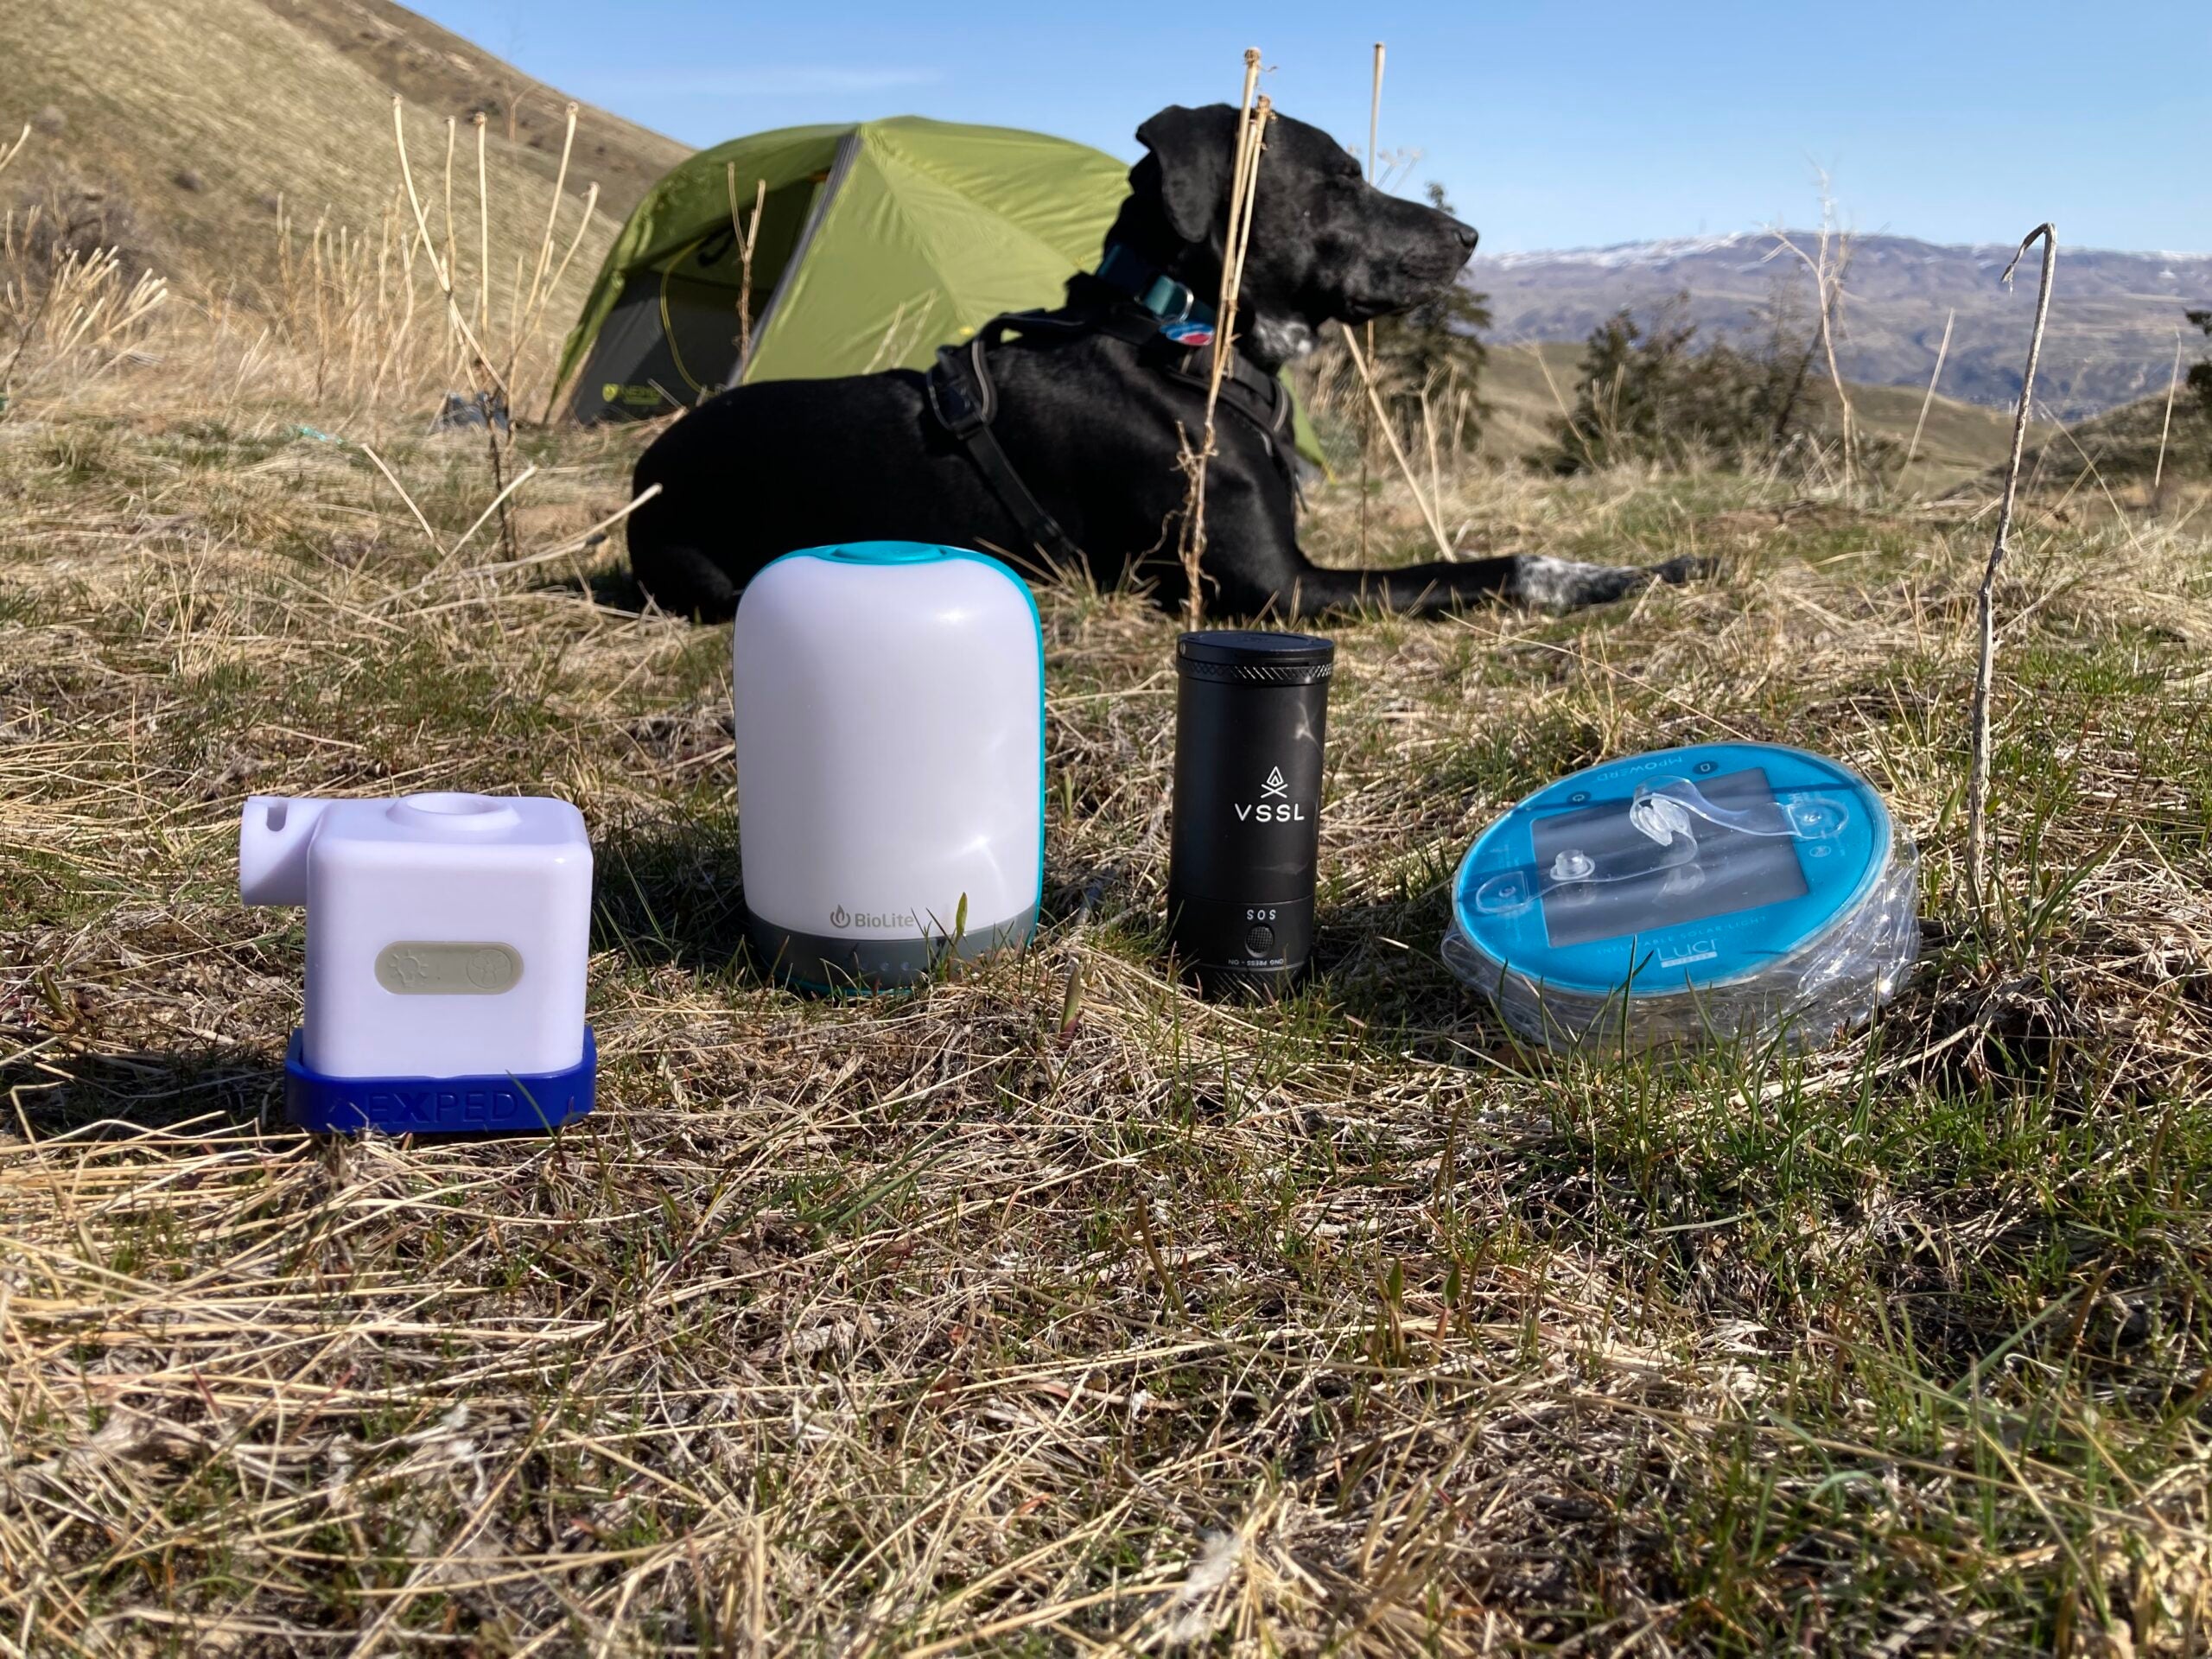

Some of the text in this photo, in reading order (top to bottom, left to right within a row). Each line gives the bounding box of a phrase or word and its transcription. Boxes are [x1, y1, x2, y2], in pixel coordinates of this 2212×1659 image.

[1597, 755, 1683, 781] MPOWERD
[1234, 803, 1305, 822] VSSL
[855, 912, 915, 929] BioLite
[1246, 909, 1277, 920] SOS
[1656, 939, 1716, 961] LUCI
[367, 1091, 518, 1123] EXPED
